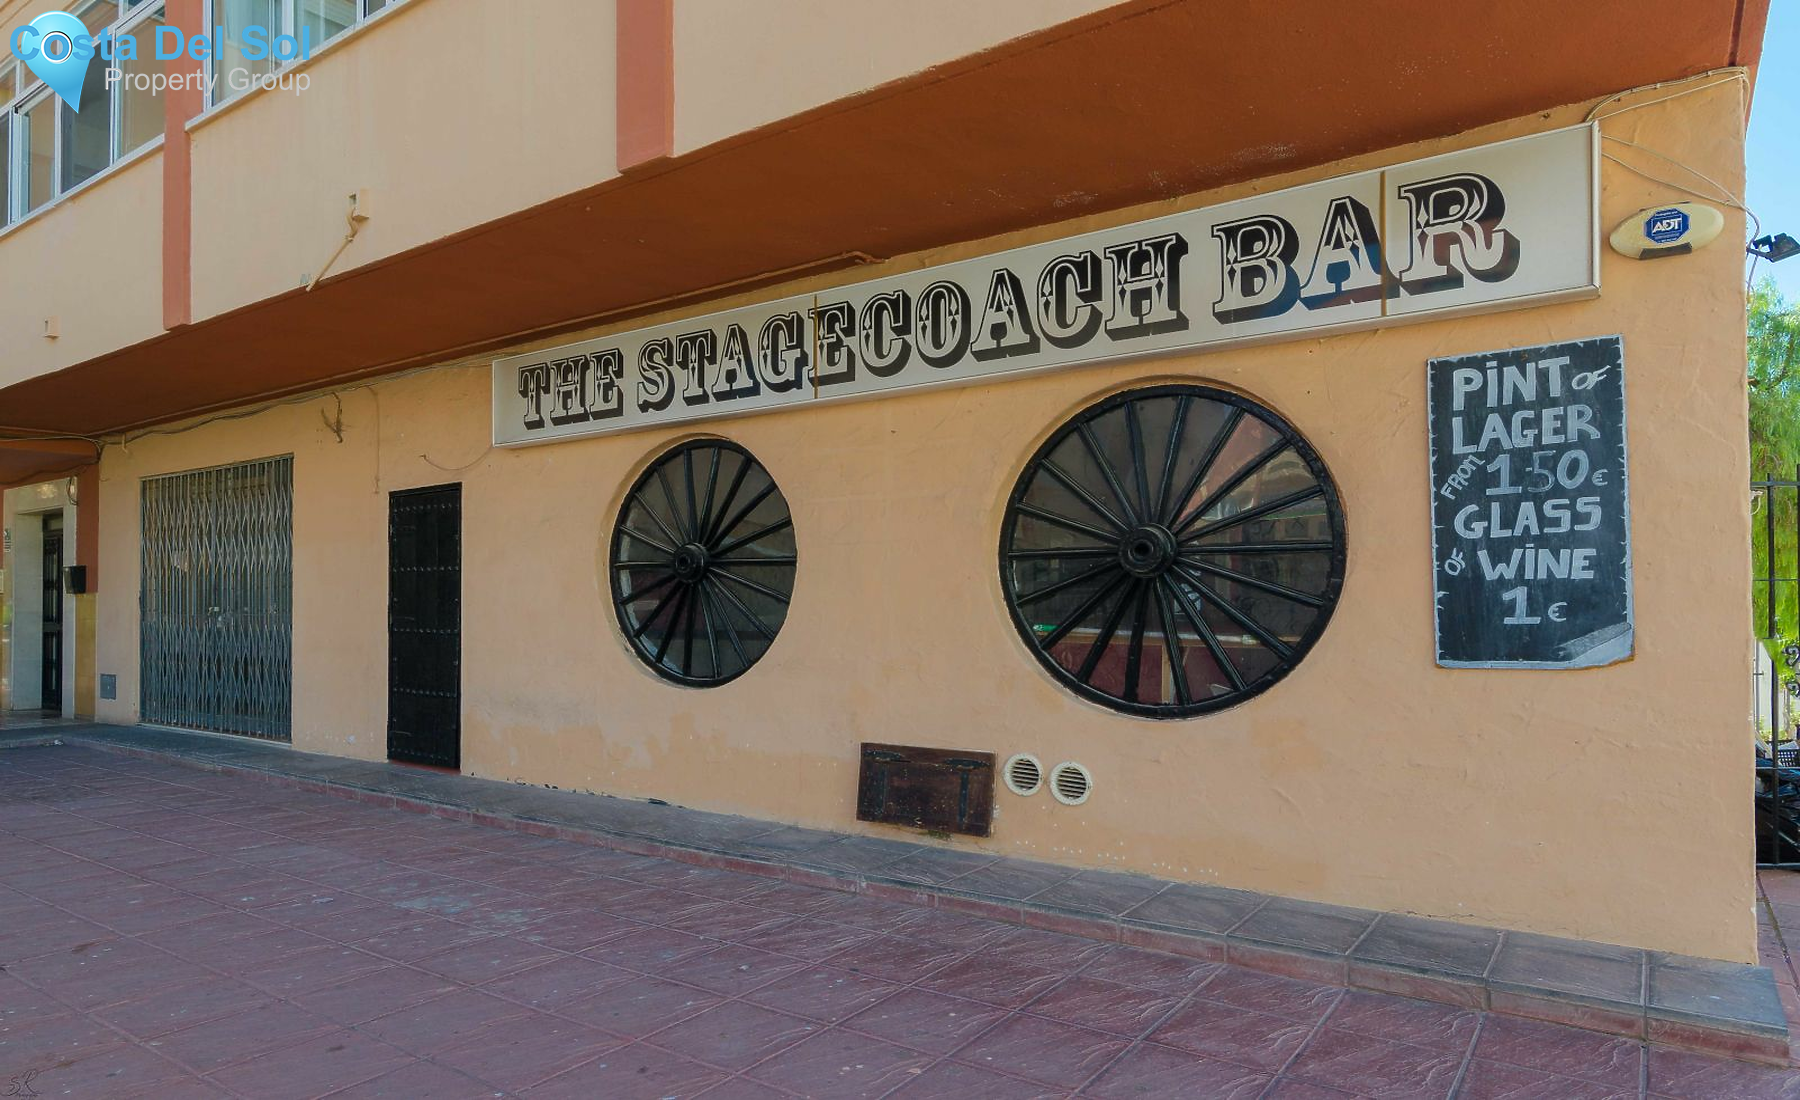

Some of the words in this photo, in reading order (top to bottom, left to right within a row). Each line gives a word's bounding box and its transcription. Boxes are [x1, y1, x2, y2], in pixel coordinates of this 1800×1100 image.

[1651, 217, 1683, 234] ADT
[518, 347, 624, 431] THE
[636, 231, 1189, 413] STAGECOACH
[1211, 172, 1521, 325] BAR
[1451, 404, 1601, 455] LAGER
[1454, 496, 1602, 539] GLASS
